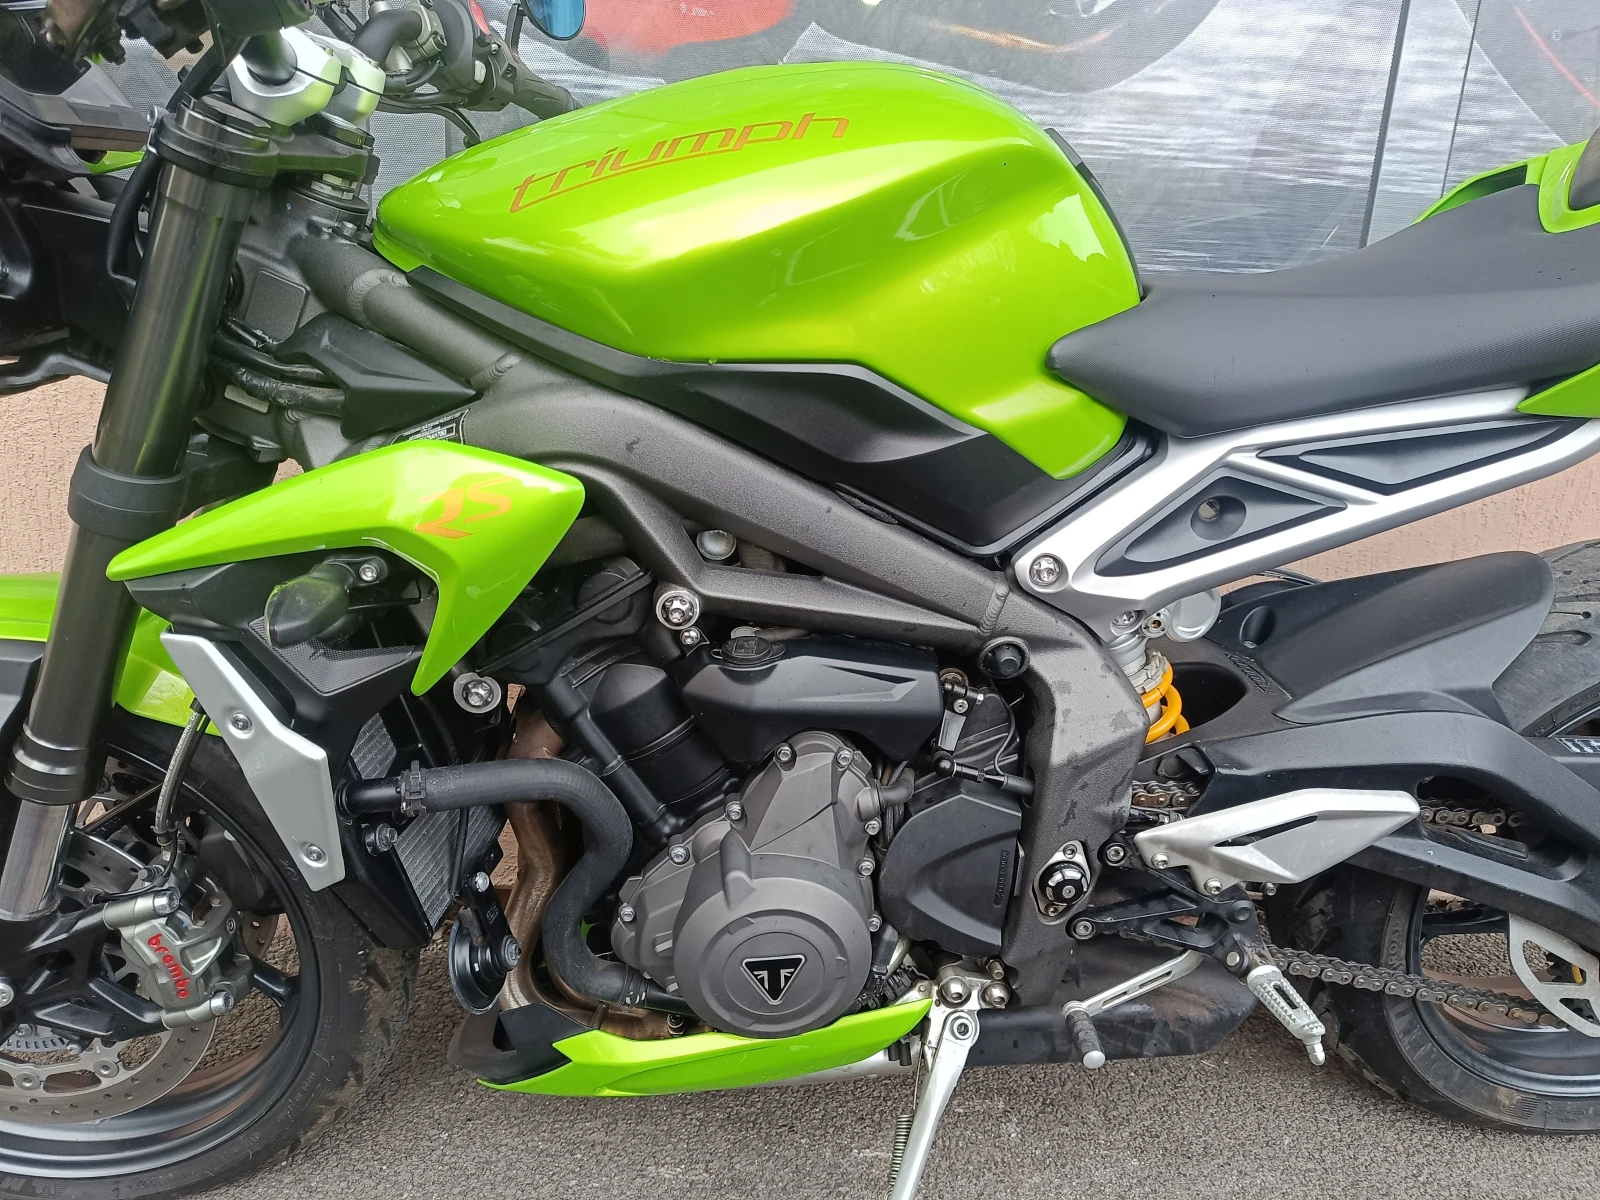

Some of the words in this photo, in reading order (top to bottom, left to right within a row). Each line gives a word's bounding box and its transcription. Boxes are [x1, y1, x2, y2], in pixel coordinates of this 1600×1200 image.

[509, 112, 850, 214] triumph
[415, 475, 514, 540] RS
[147, 933, 191, 999] brembo
